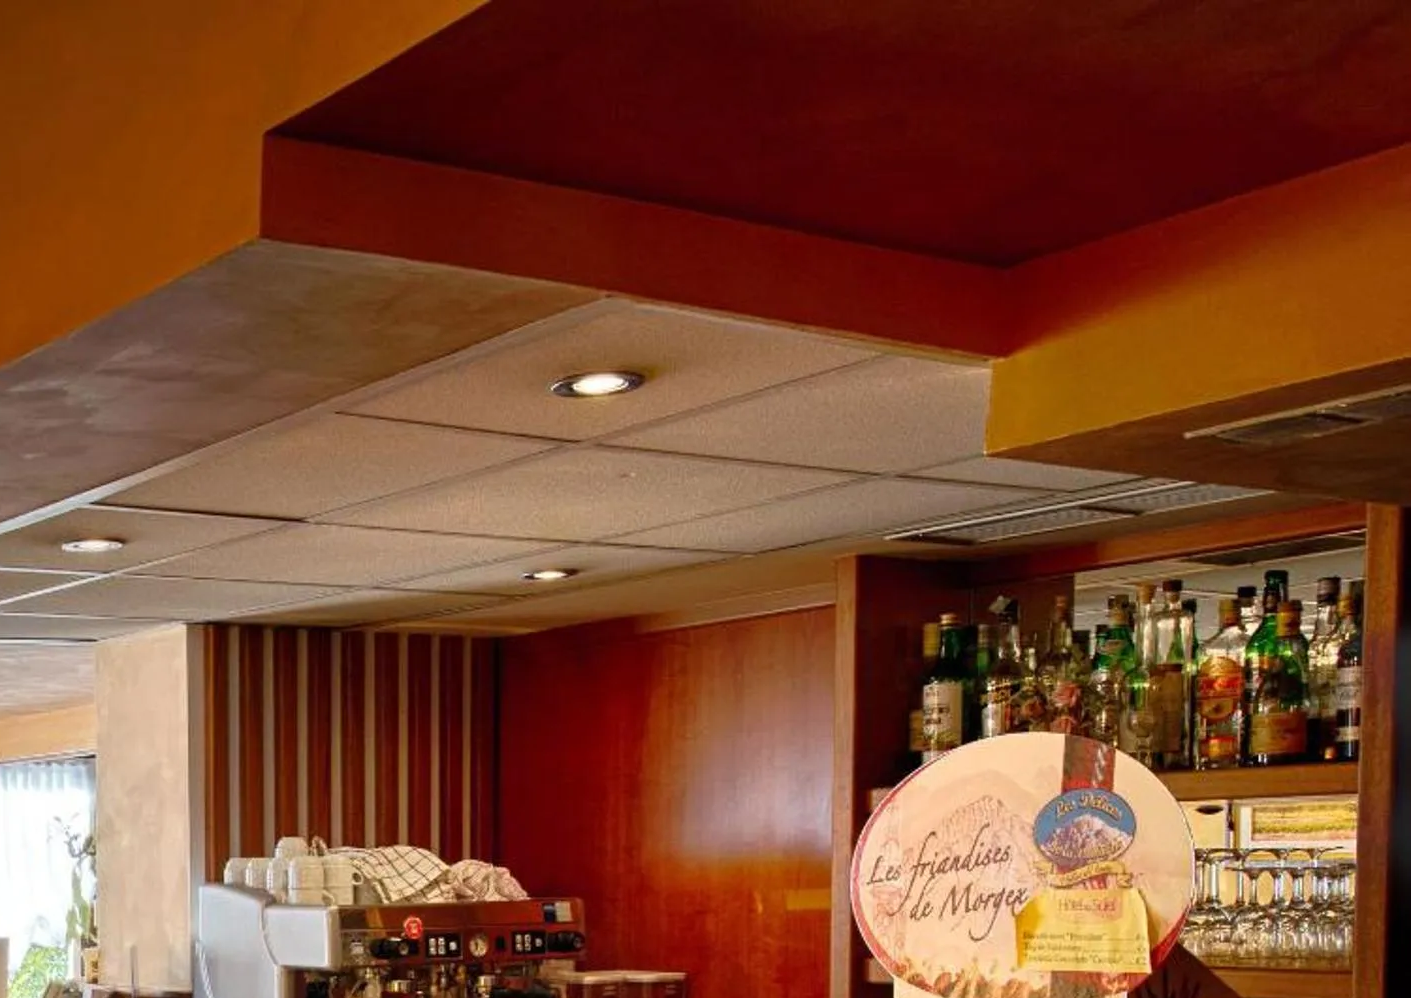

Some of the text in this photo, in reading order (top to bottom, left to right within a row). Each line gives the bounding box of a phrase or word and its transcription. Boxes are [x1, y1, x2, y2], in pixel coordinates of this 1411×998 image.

[866, 855, 901, 885] Les
[886, 823, 1011, 917] friandises
[909, 875, 1029, 942] de Morgex
